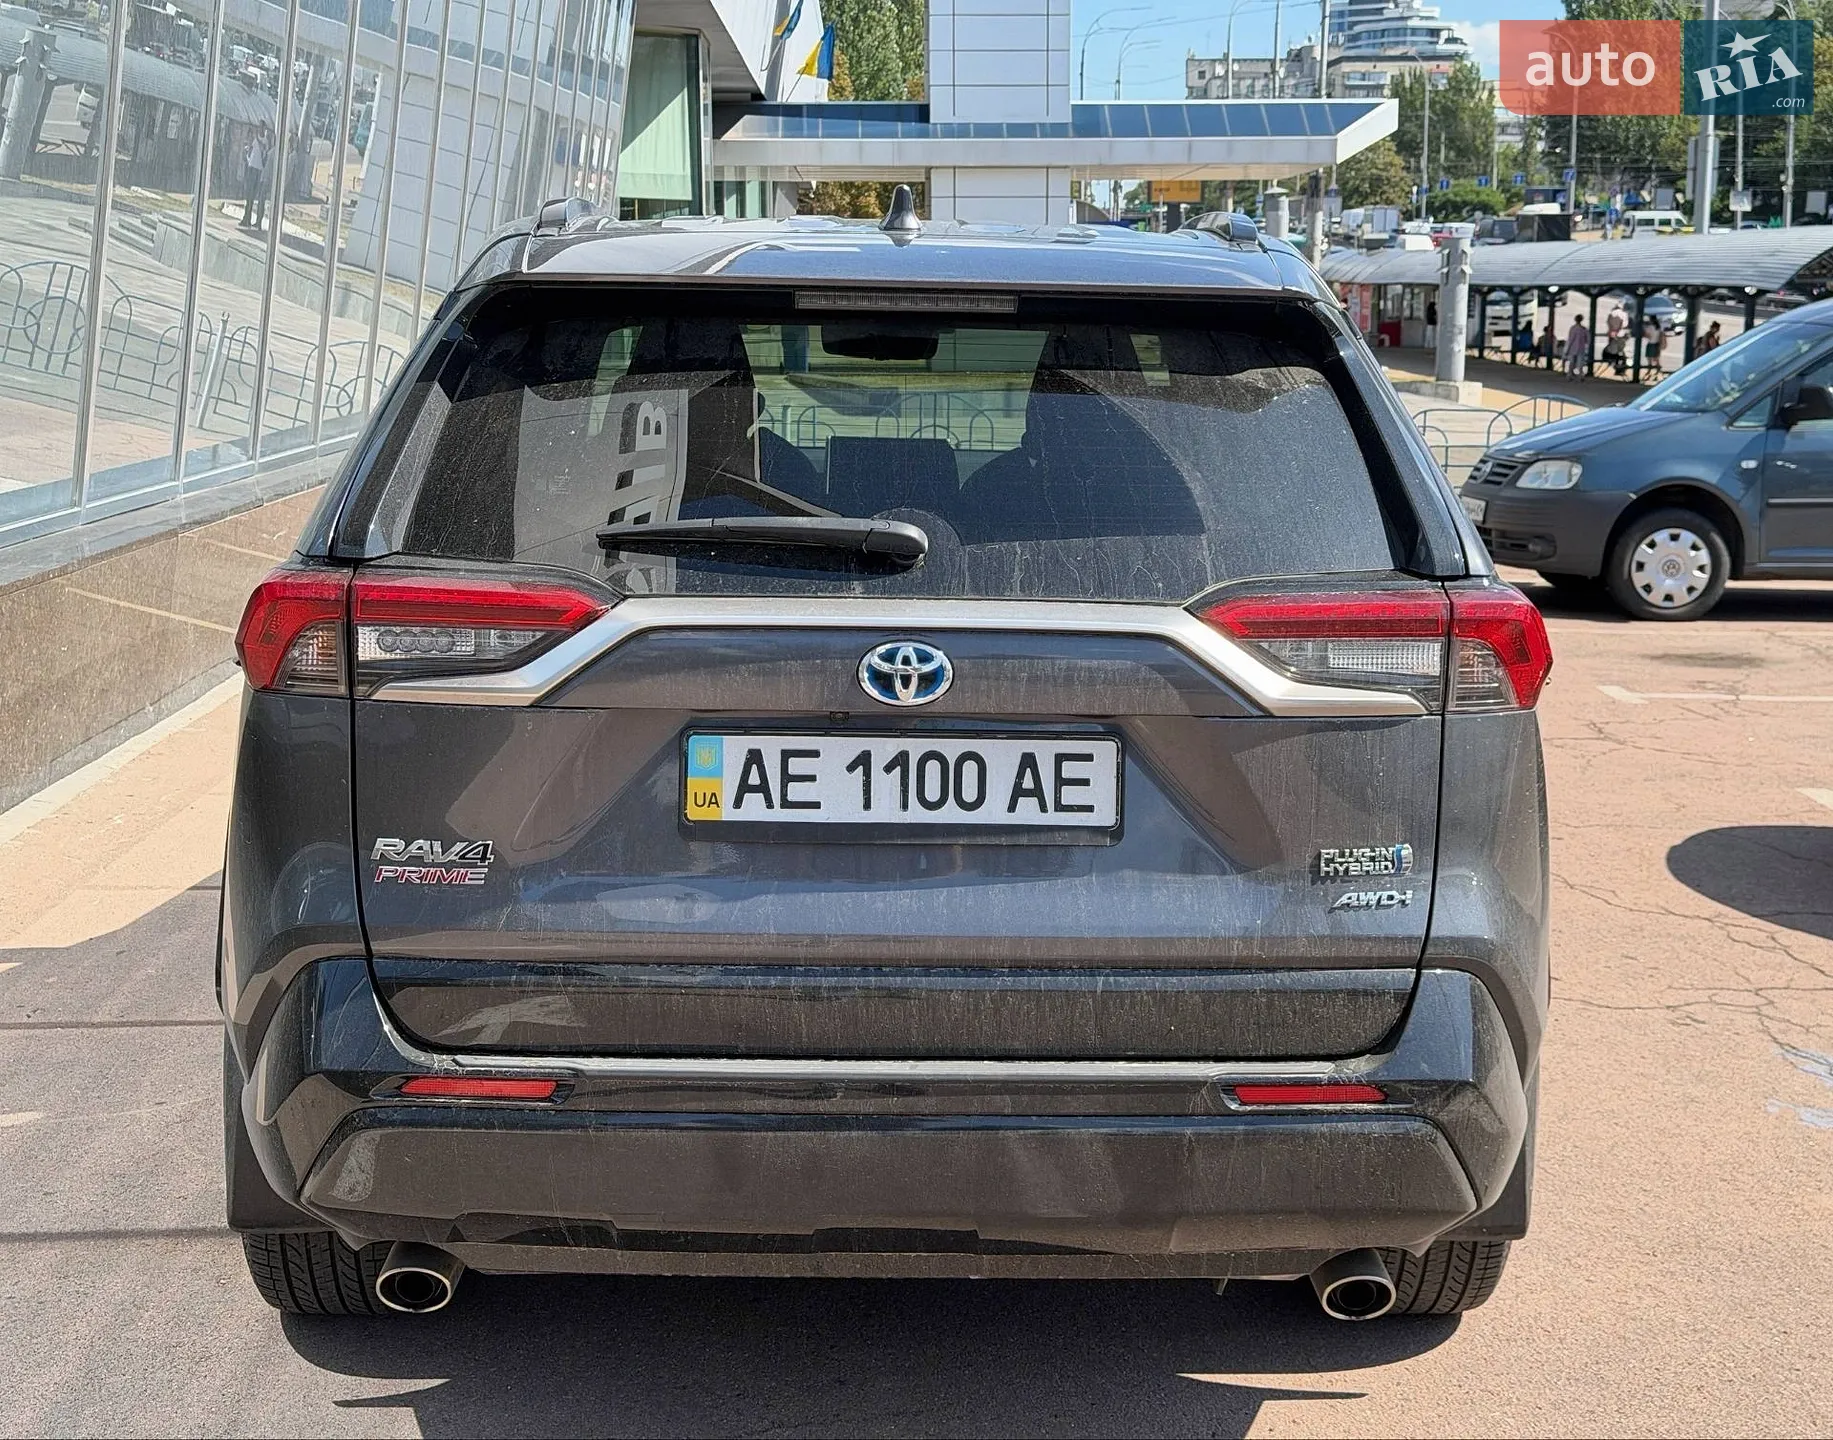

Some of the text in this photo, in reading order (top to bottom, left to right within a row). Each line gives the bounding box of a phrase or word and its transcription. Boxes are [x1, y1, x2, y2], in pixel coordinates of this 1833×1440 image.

[732, 748, 1096, 814] AE 1100 AE
[693, 791, 721, 809] UA
[370, 837, 495, 866] RAV4
[374, 865, 489, 885] PRIME
[1320, 861, 1395, 877] HYBRID
